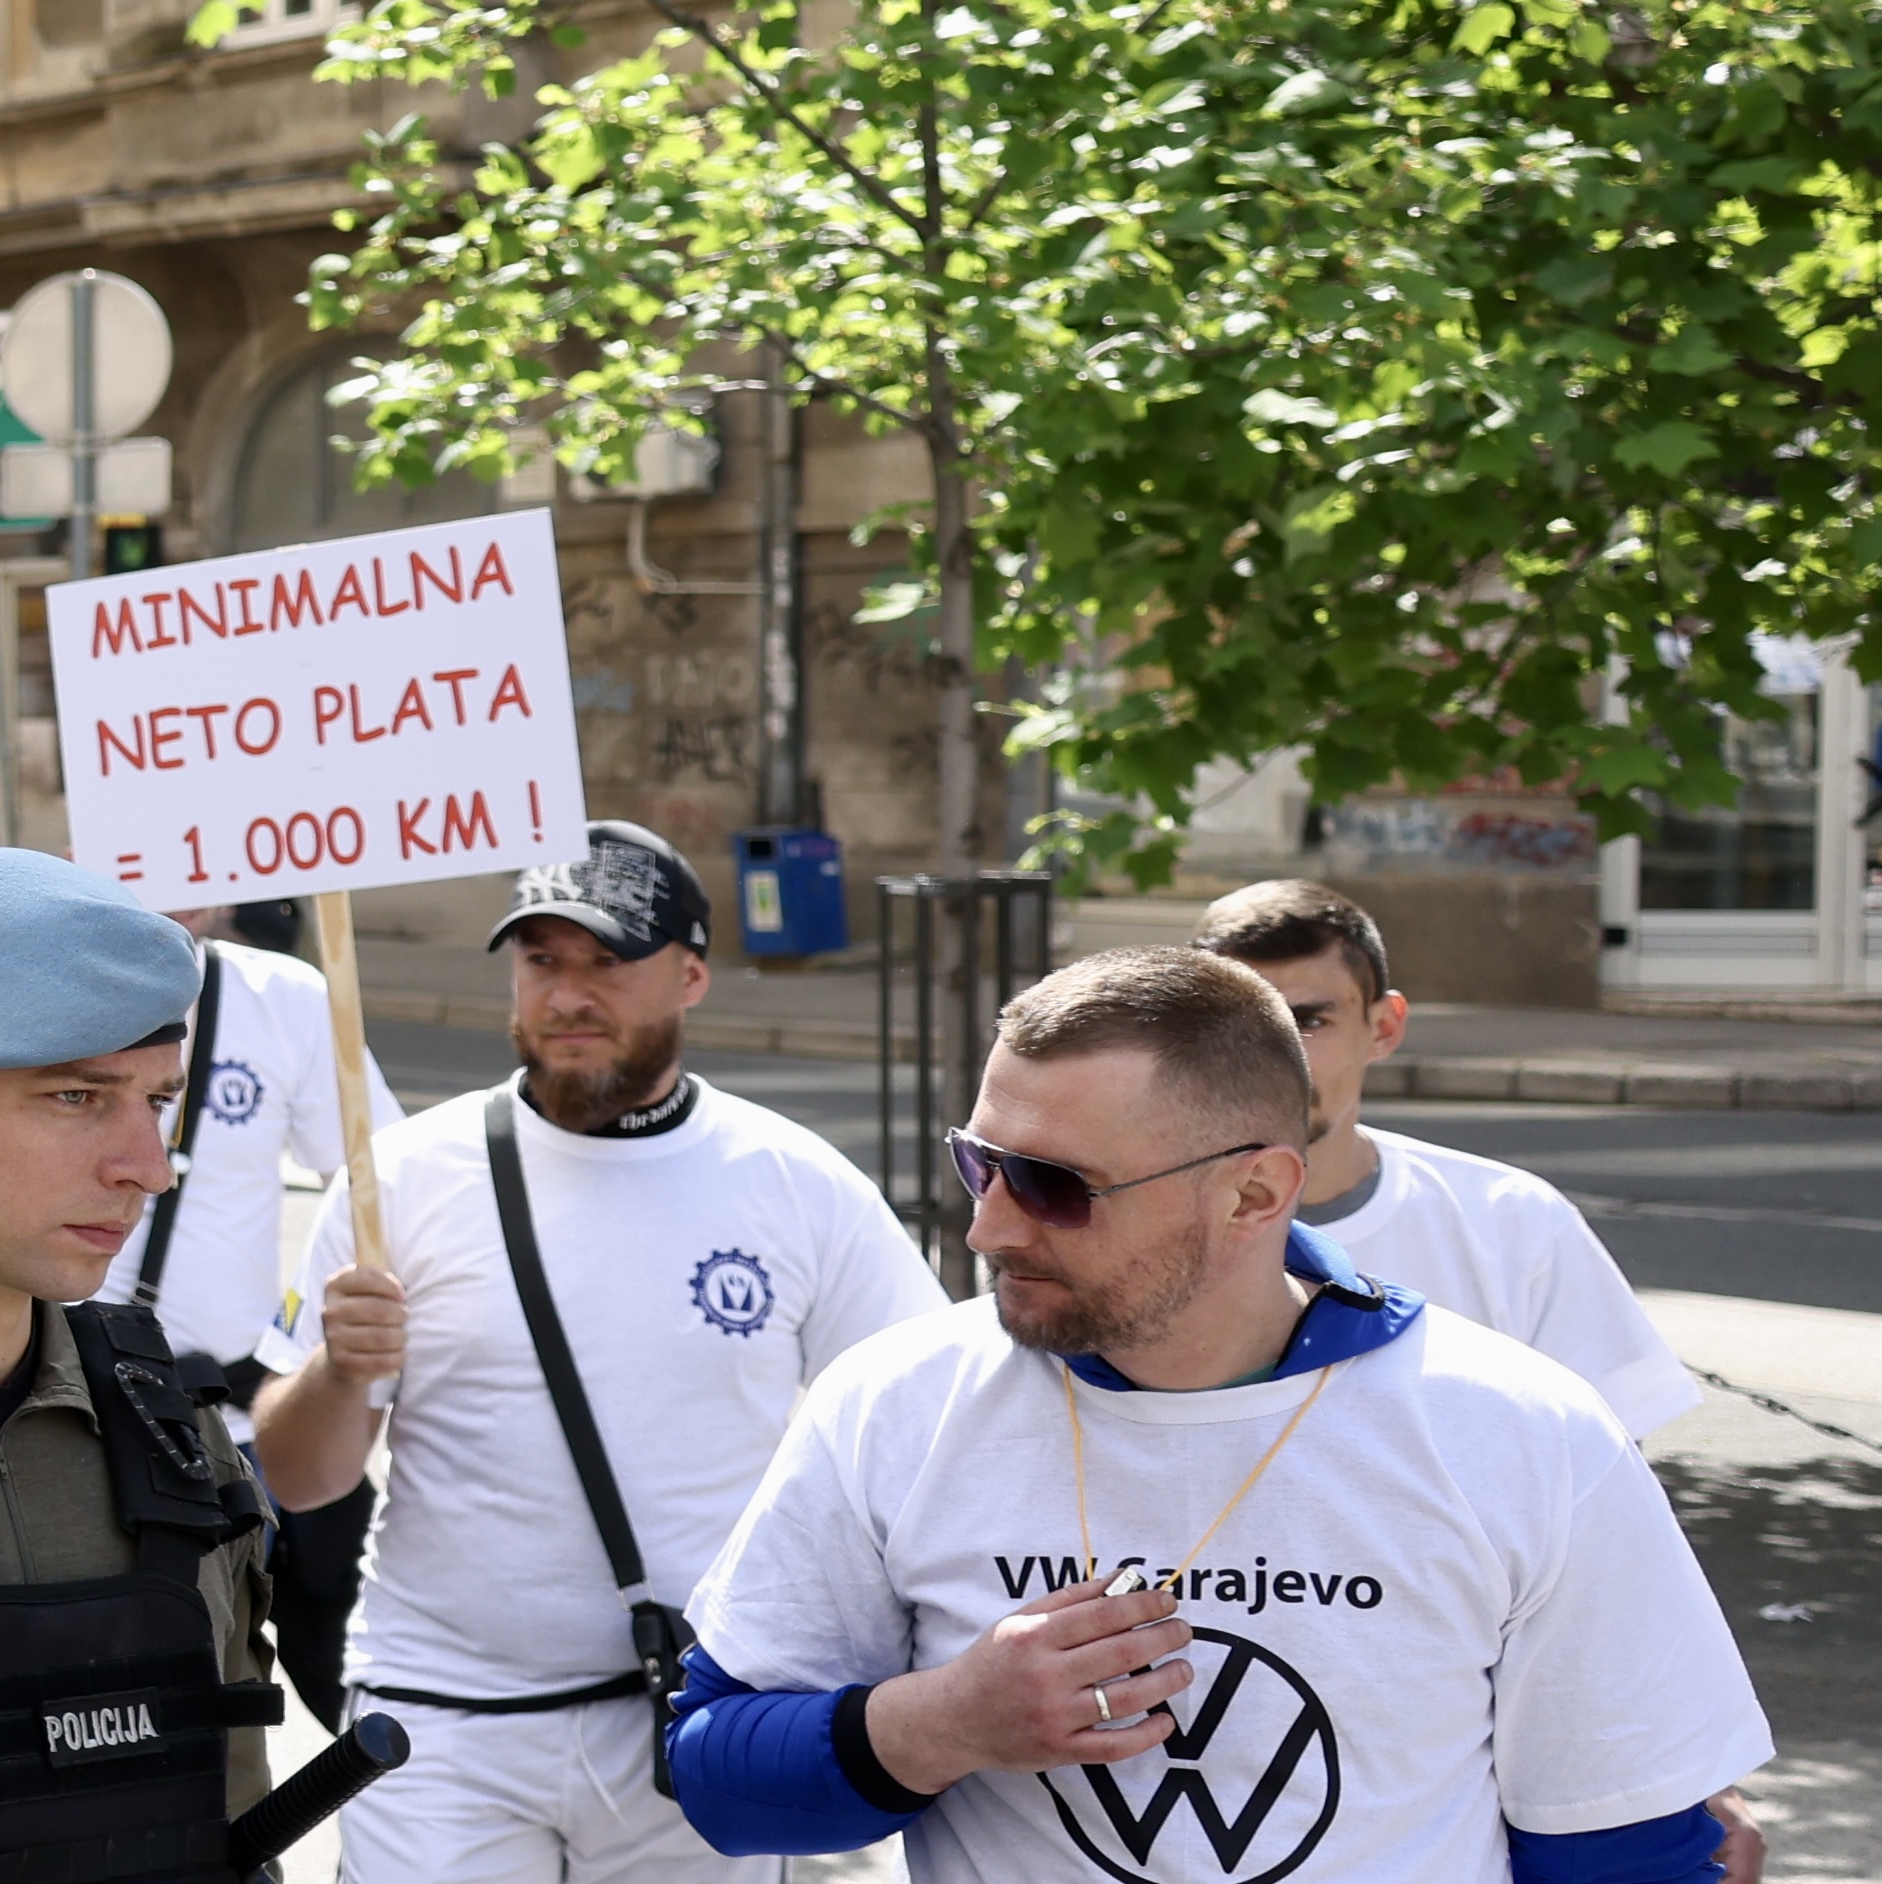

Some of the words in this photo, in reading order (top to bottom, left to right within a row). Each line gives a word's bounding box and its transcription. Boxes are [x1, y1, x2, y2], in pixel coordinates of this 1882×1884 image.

[92, 541, 514, 658] MINIMALNA
[96, 696, 284, 777] NETO
[313, 663, 533, 746] PLATA
[182, 806, 367, 884] 1.000
[397, 789, 500, 860] KM
[43, 1702, 161, 1752] POLICIJA
